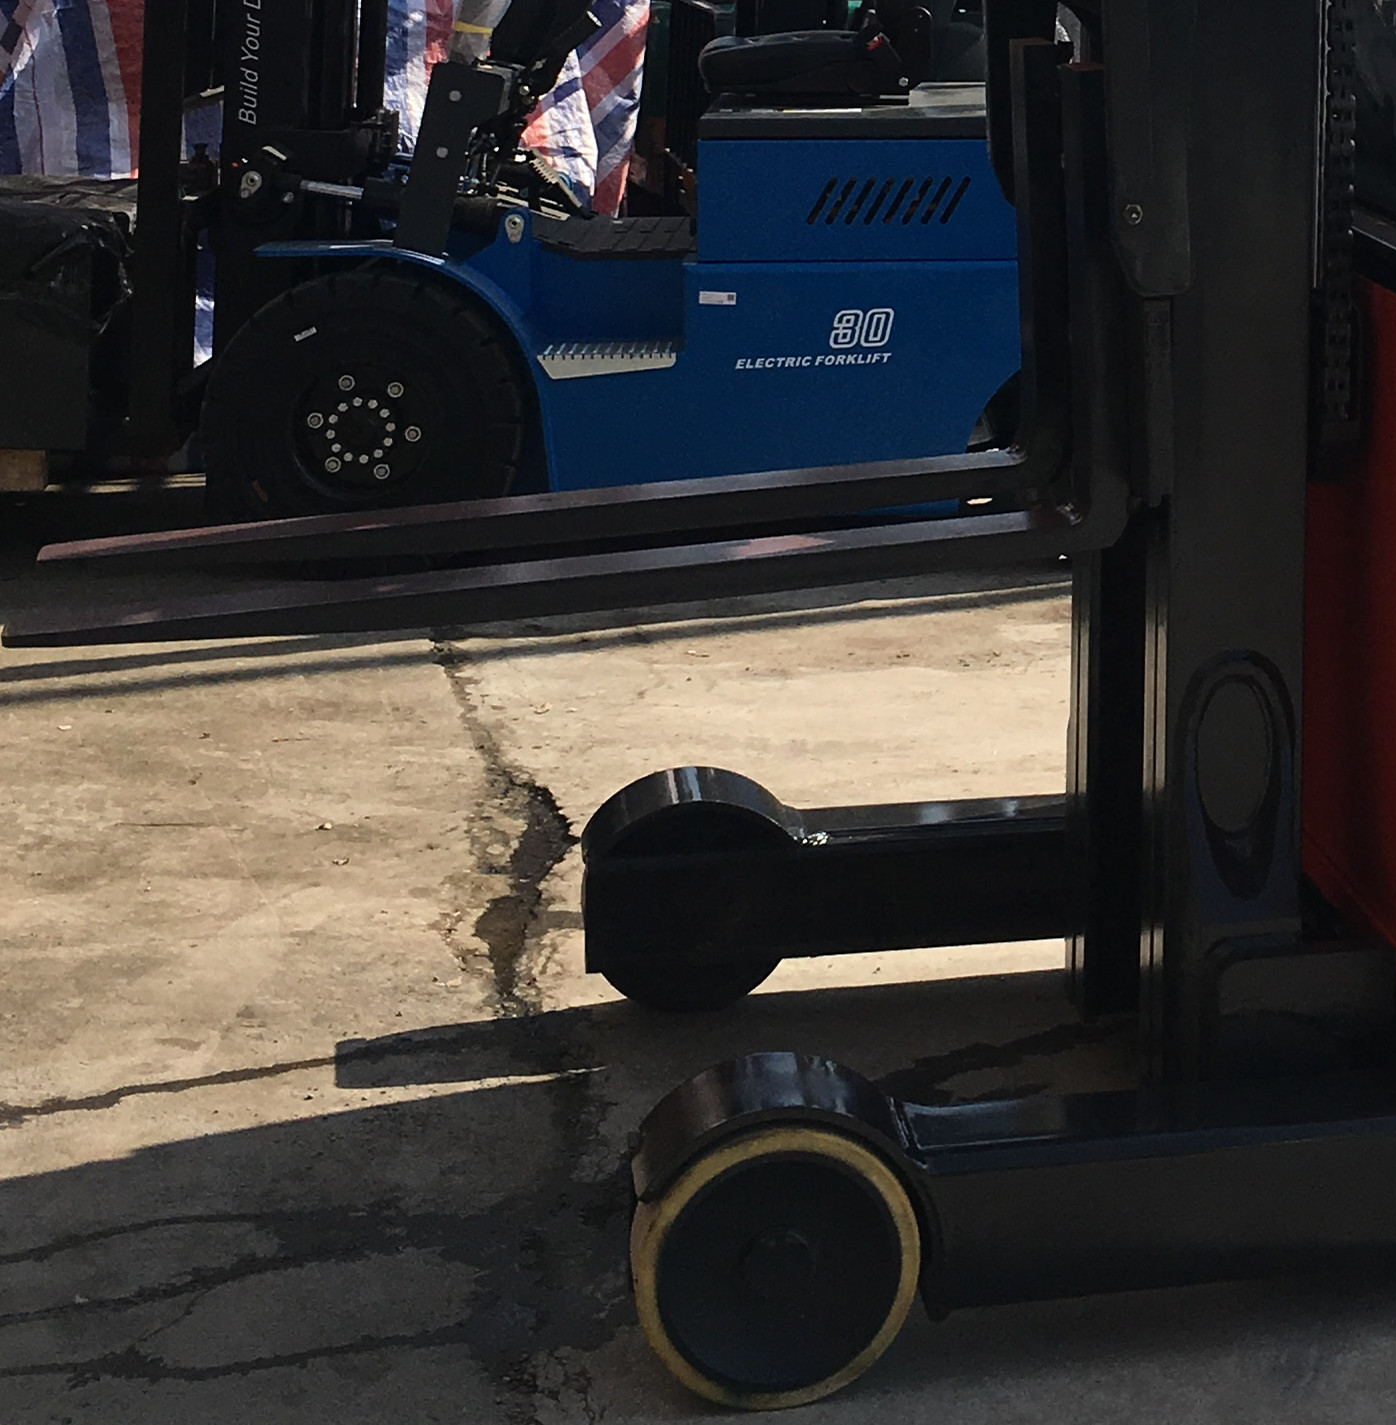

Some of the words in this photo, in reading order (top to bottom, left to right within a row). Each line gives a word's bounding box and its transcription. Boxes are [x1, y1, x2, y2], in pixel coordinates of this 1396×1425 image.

[241, 13, 261, 61] Your
[238, 67, 258, 125] Build
[829, 307, 895, 349] 30
[735, 356, 812, 370] ELECTRIC
[815, 352, 892, 366] FORKLIFT
